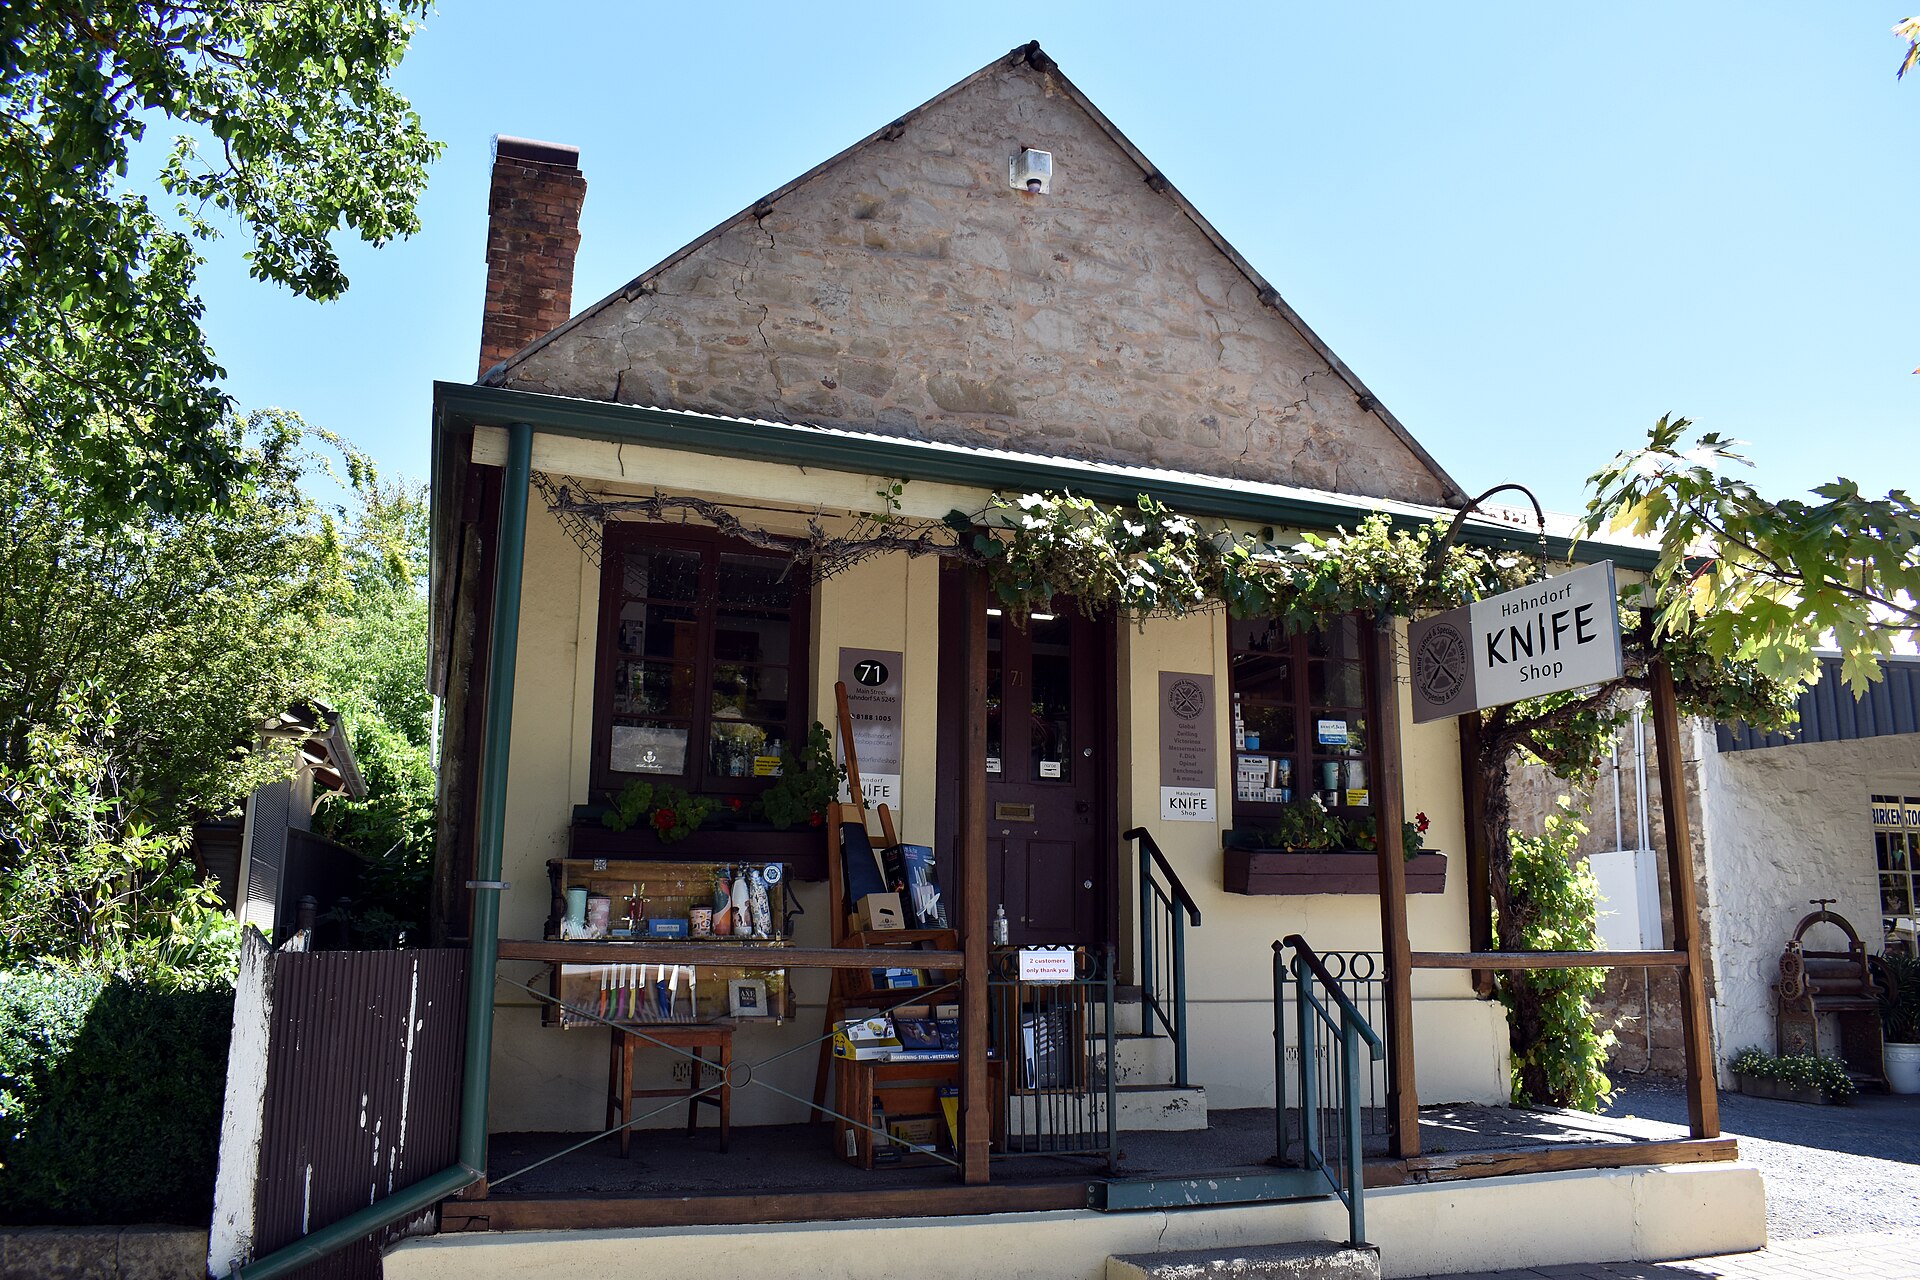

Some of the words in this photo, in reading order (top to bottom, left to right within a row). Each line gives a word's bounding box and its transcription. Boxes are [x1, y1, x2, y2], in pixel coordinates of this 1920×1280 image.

[1501, 583, 1572, 617] Hahndorf
[1486, 602, 1598, 668] KNIFE
[1418, 632, 1432, 656] Crafted
[1457, 640, 1465, 664] Knives
[860, 664, 880, 683] 71
[1010, 670, 1023, 686] 71
[1519, 661, 1563, 682] Shop
[1170, 797, 1208, 810] KNIFE
